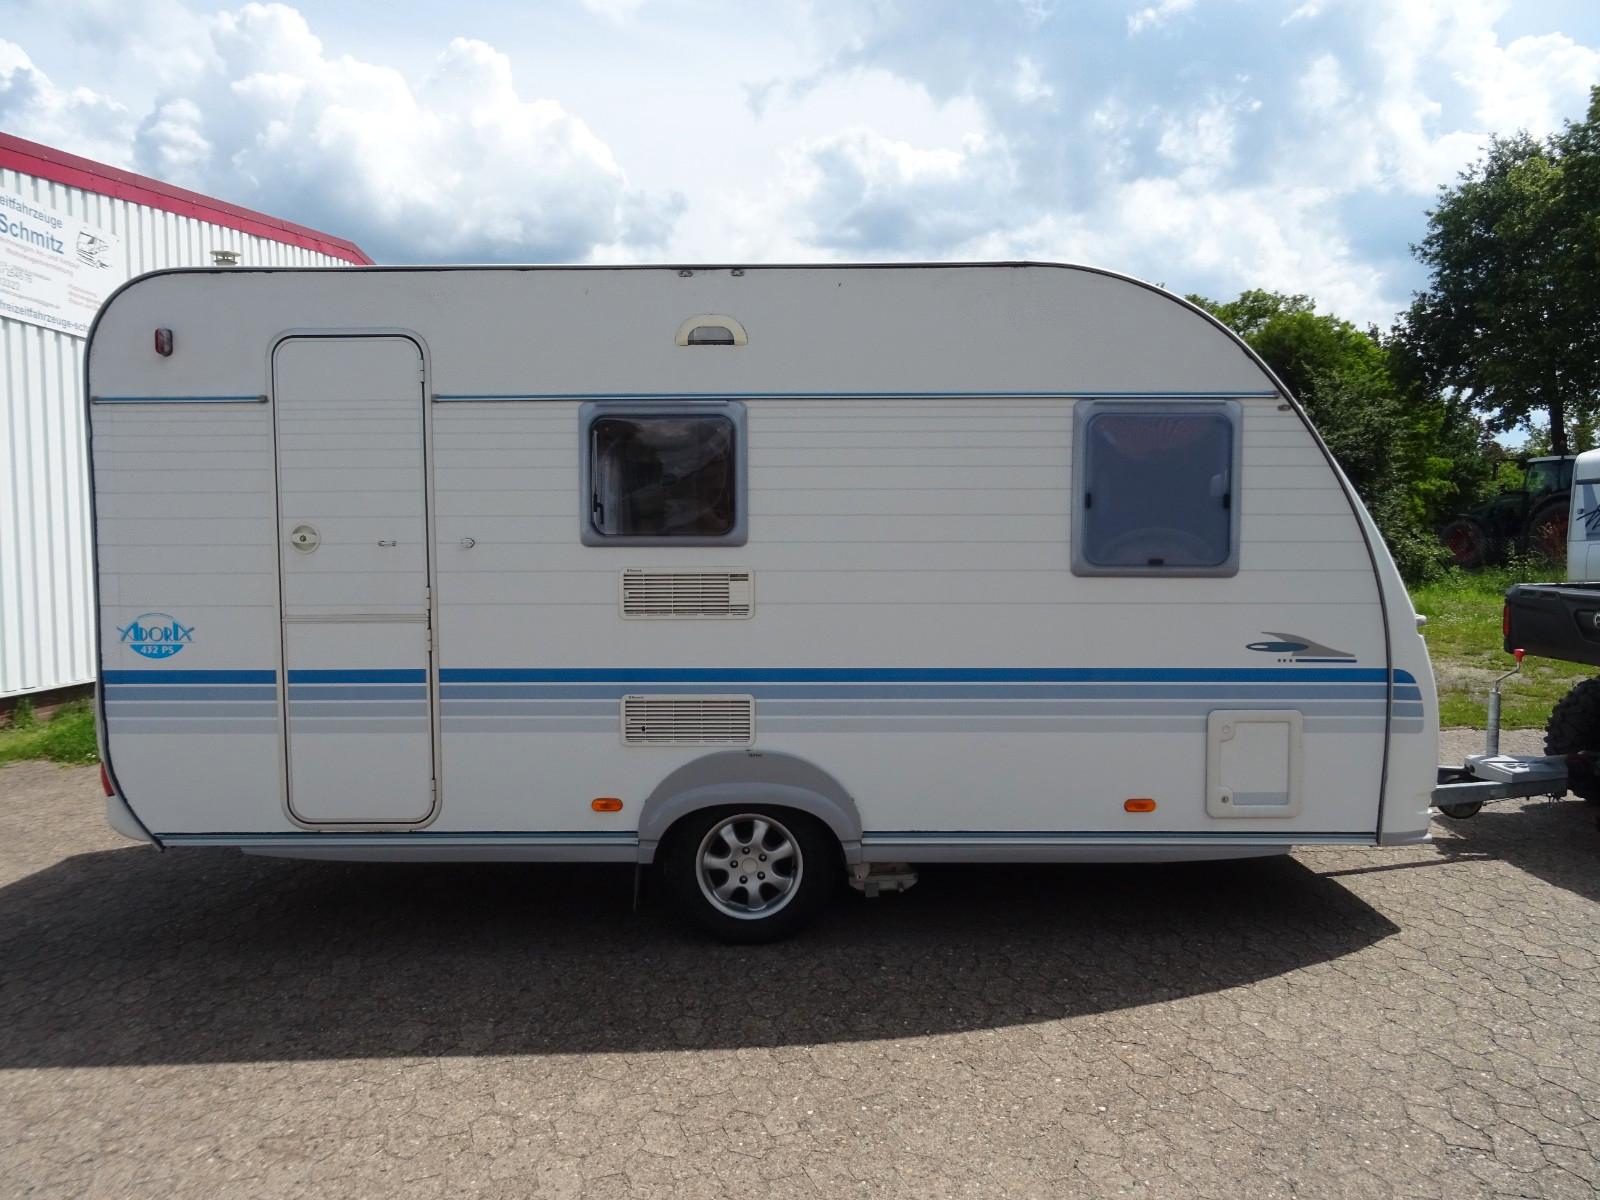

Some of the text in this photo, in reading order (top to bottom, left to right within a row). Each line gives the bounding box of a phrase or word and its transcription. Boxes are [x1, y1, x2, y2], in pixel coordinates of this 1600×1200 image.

[0, 213, 64, 255] Schmitz
[140, 645, 175, 654] 432 PS
